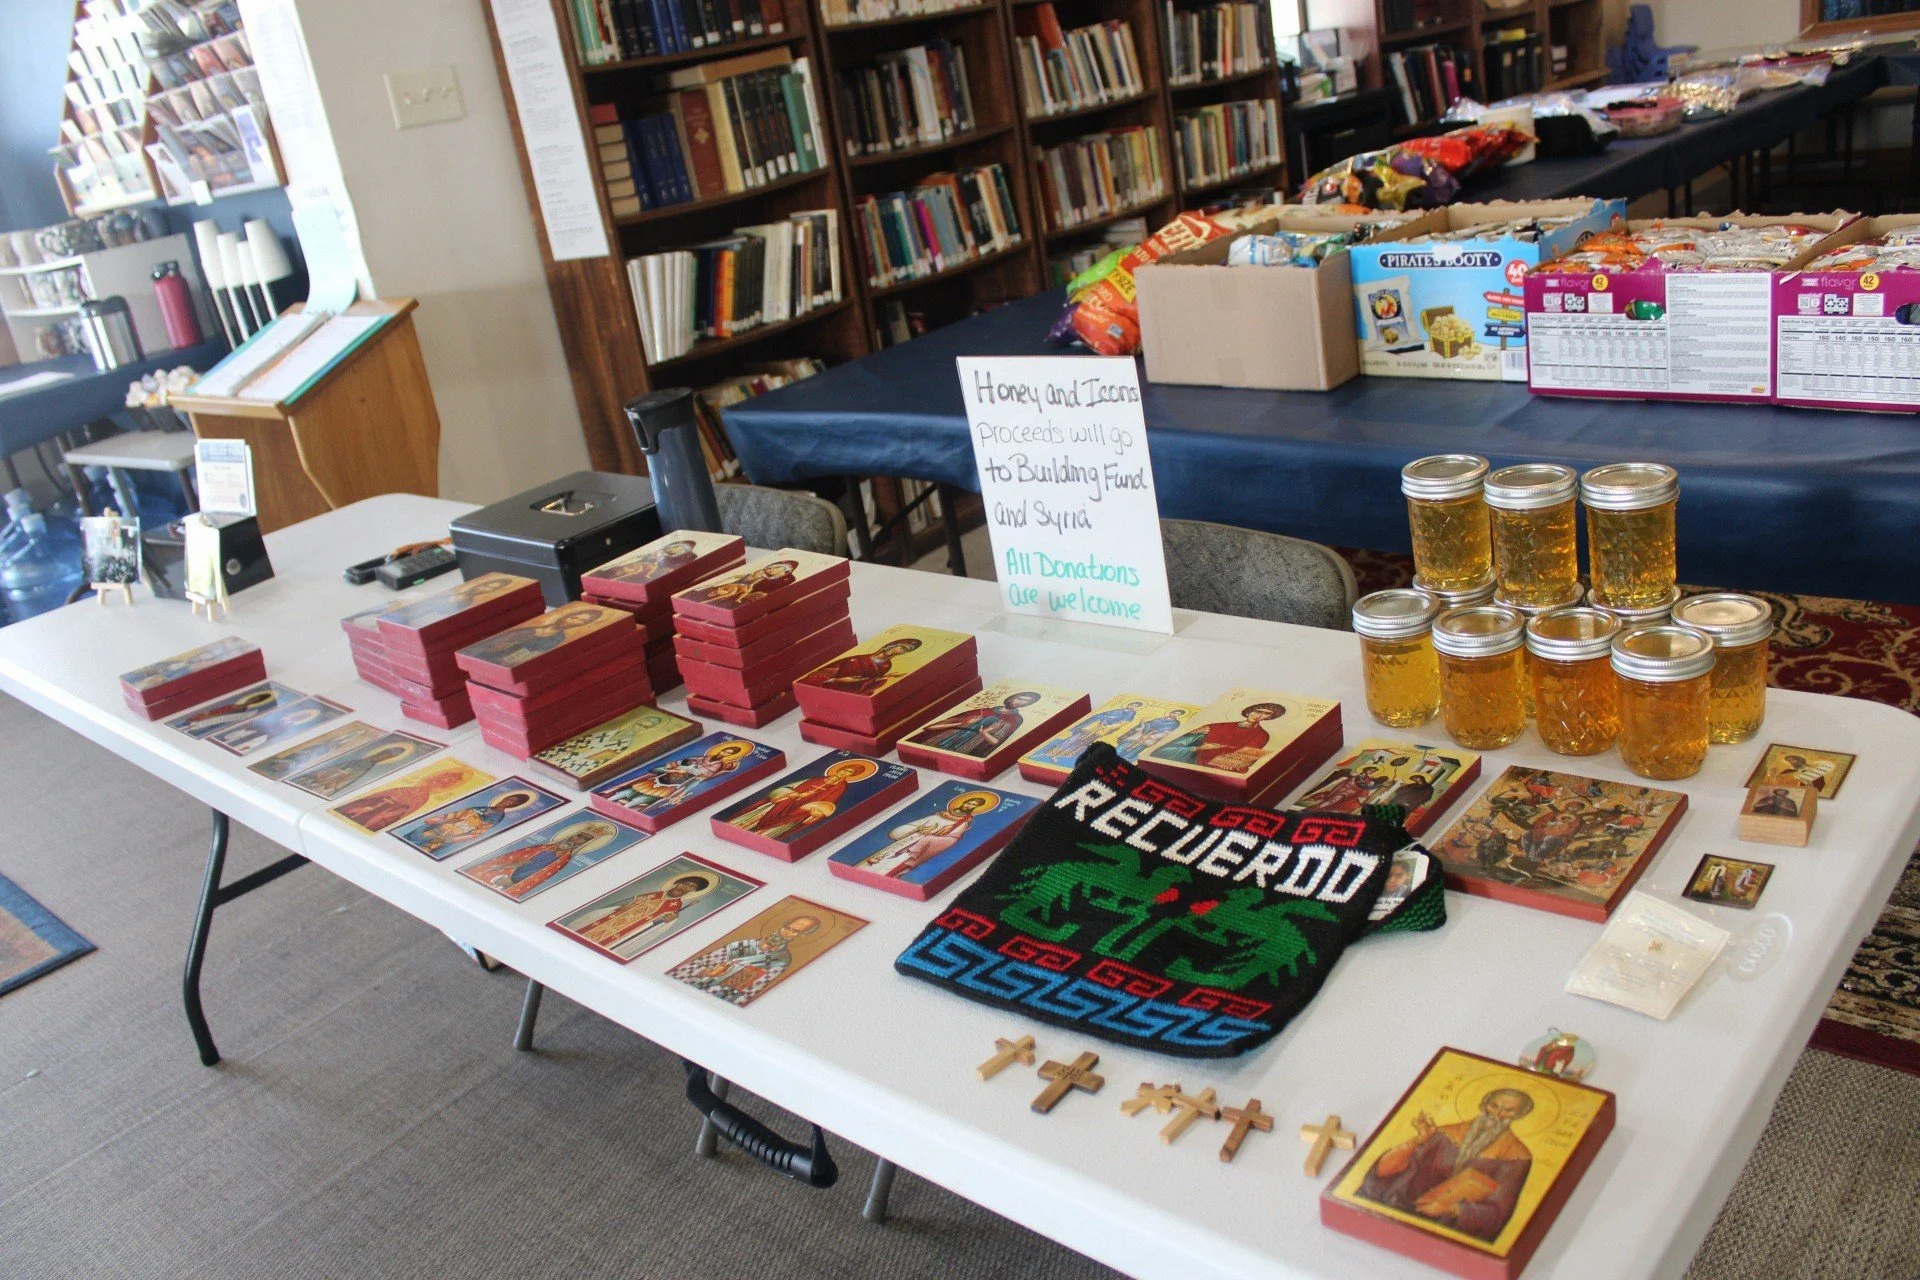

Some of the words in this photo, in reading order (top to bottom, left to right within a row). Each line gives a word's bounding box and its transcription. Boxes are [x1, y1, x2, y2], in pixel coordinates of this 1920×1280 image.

[1821, 276, 1857, 287] flavor
[1863, 275, 1874, 285] 42
[975, 370, 1043, 413] Honey
[1046, 380, 1081, 408] and
[1082, 377, 1140, 408] Icons
[1072, 422, 1106, 444] will
[1111, 427, 1133, 455] go
[985, 456, 1012, 483] to
[1009, 453, 1103, 502] Building
[1104, 462, 1149, 492] Fund
[994, 498, 1027, 529] and
[1033, 500, 1092, 535] Syria
[1006, 547, 1032, 576] All
[1033, 550, 1140, 587] Donations
[1009, 583, 1039, 607] are
[1048, 586, 1142, 621] welcome
[1054, 780, 1379, 903] RECUERDO
